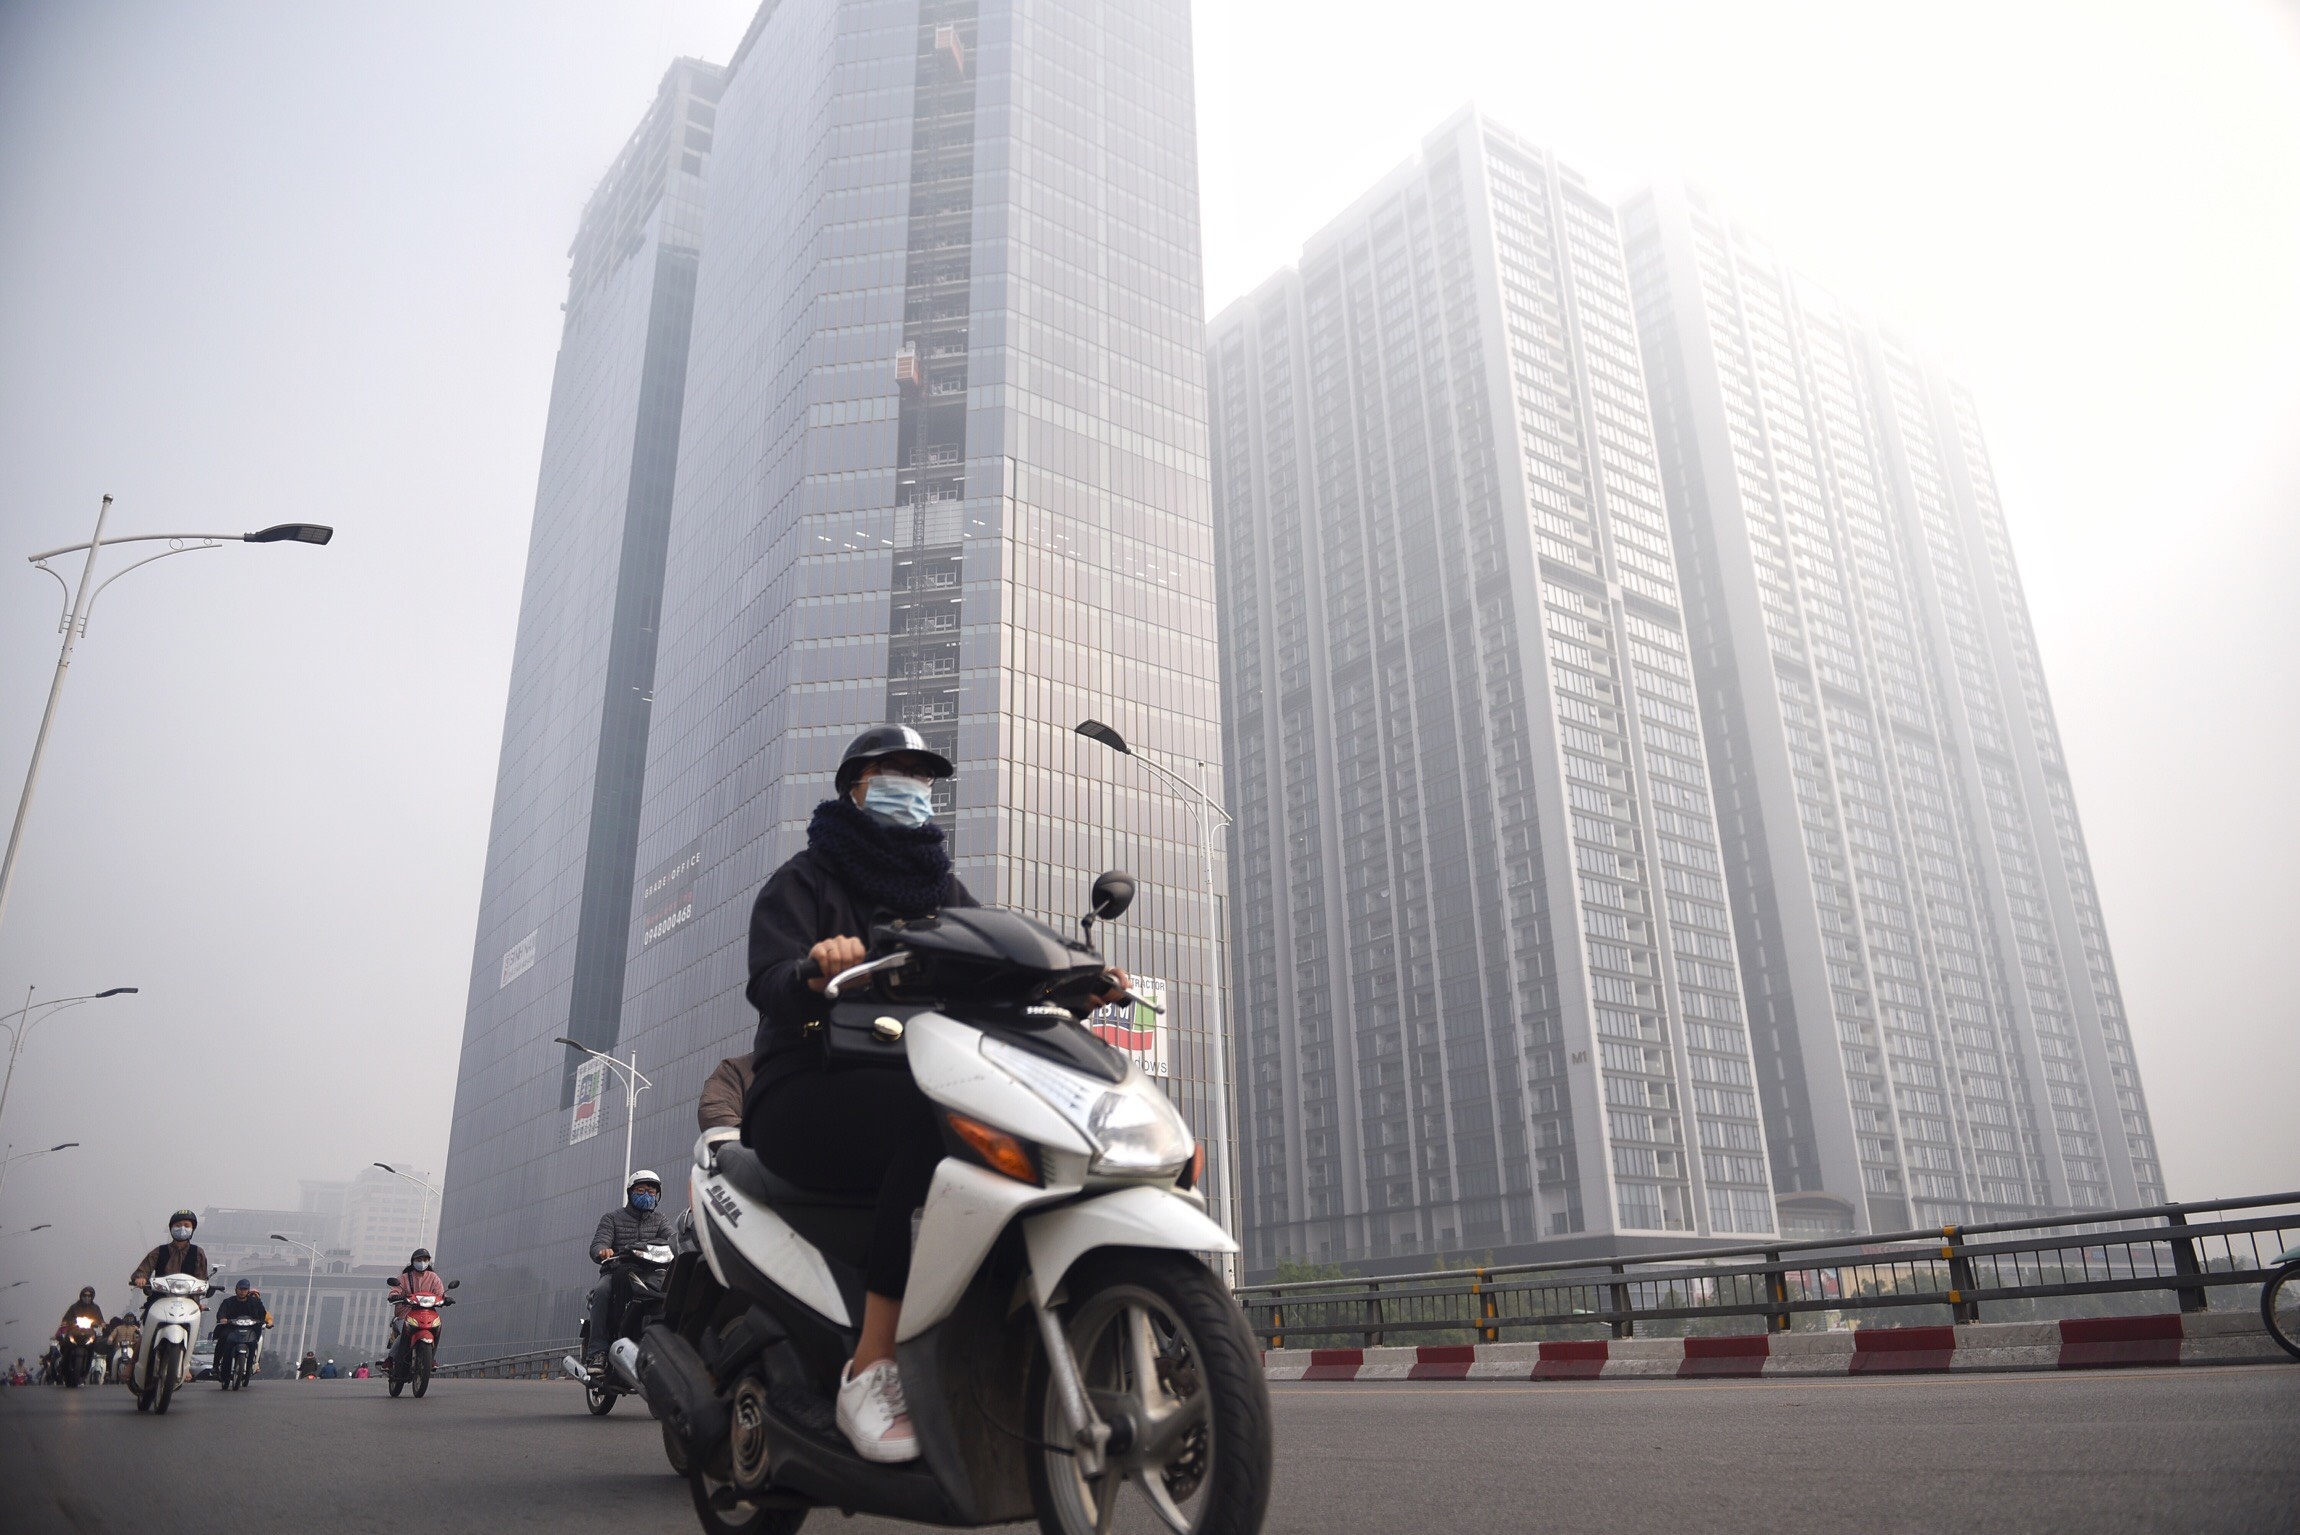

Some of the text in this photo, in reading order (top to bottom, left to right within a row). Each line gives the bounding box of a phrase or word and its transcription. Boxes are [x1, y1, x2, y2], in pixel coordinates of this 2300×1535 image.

[644, 876, 667, 899] GRADE
[671, 852, 701, 880] OFFICE
[1571, 1050, 1588, 1065] M1
